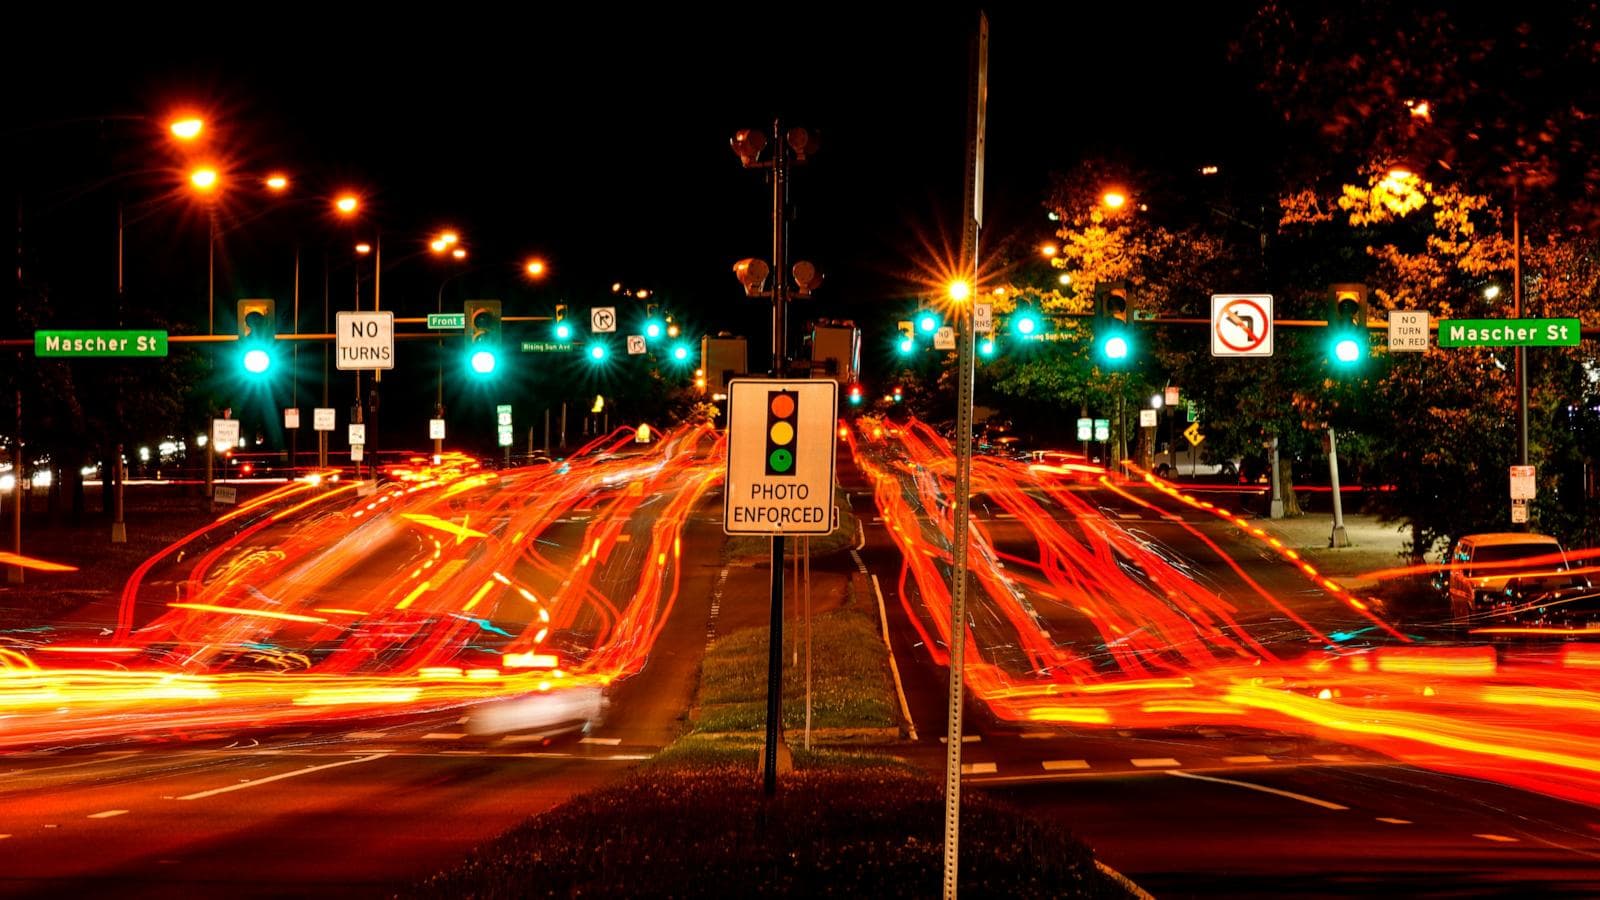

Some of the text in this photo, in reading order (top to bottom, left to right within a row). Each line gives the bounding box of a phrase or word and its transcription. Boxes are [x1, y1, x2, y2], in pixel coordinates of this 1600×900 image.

[432, 316, 456, 326] Front
[975, 320, 990, 328] RNS
[1402, 316, 1416, 324] NO
[351, 321, 378, 338] NO
[1398, 327, 1421, 335] TURN
[1450, 325, 1568, 341] Mascher St
[45, 335, 156, 351] Mascher St
[1392, 338, 1425, 346] ON RED
[340, 346, 390, 360] TURNS
[751, 483, 809, 500] PHOTO
[734, 506, 824, 523] ENFORCED
